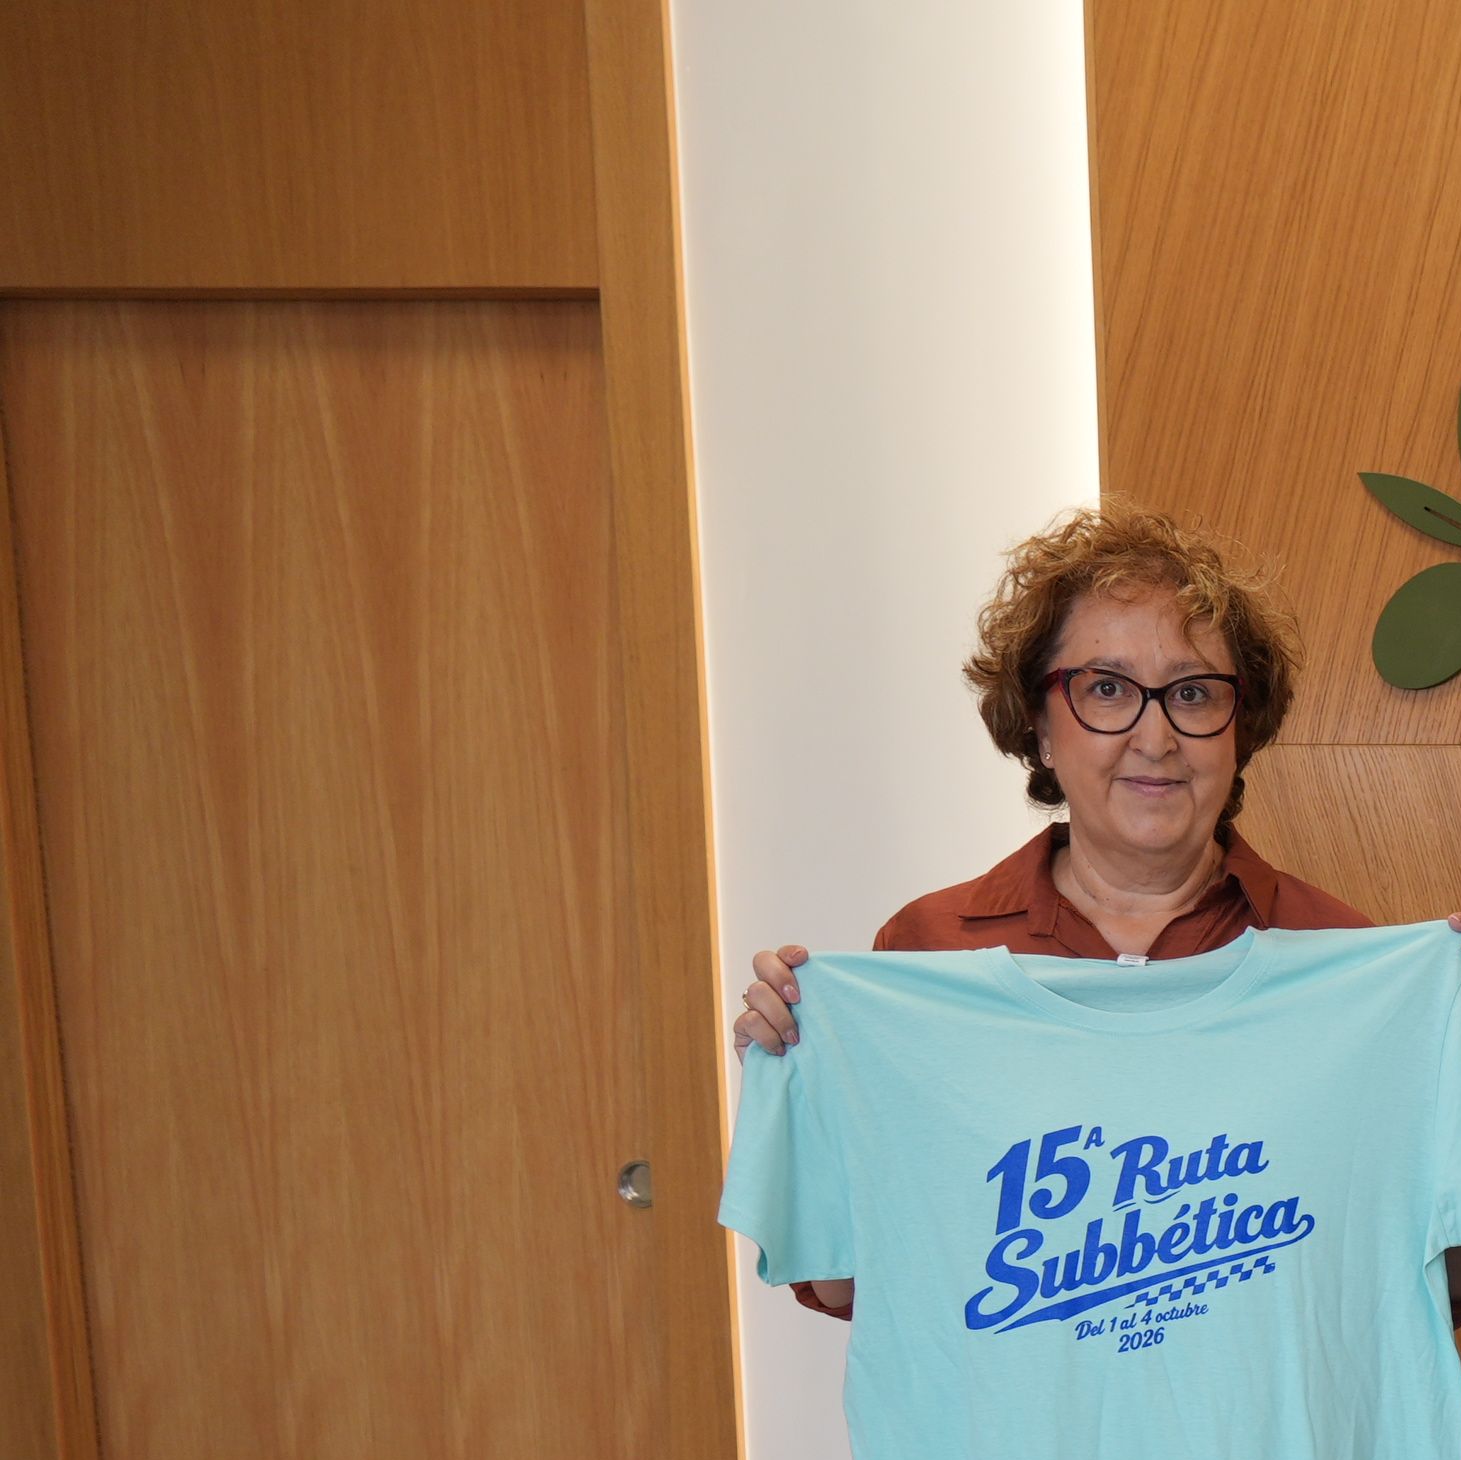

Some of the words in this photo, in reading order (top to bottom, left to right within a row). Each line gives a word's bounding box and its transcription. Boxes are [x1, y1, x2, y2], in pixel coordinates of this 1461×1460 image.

[1110, 1133, 1269, 1207] Ruta
[964, 1193, 1315, 1330] Subbética
[1075, 1319, 1105, 1340] Del
[1109, 1317, 1118, 1333] 1
[1119, 1313, 1137, 1330] al
[1140, 1310, 1152, 1326] 4
[1155, 1302, 1209, 1326] octubre
[1118, 1327, 1165, 1352] 2026
